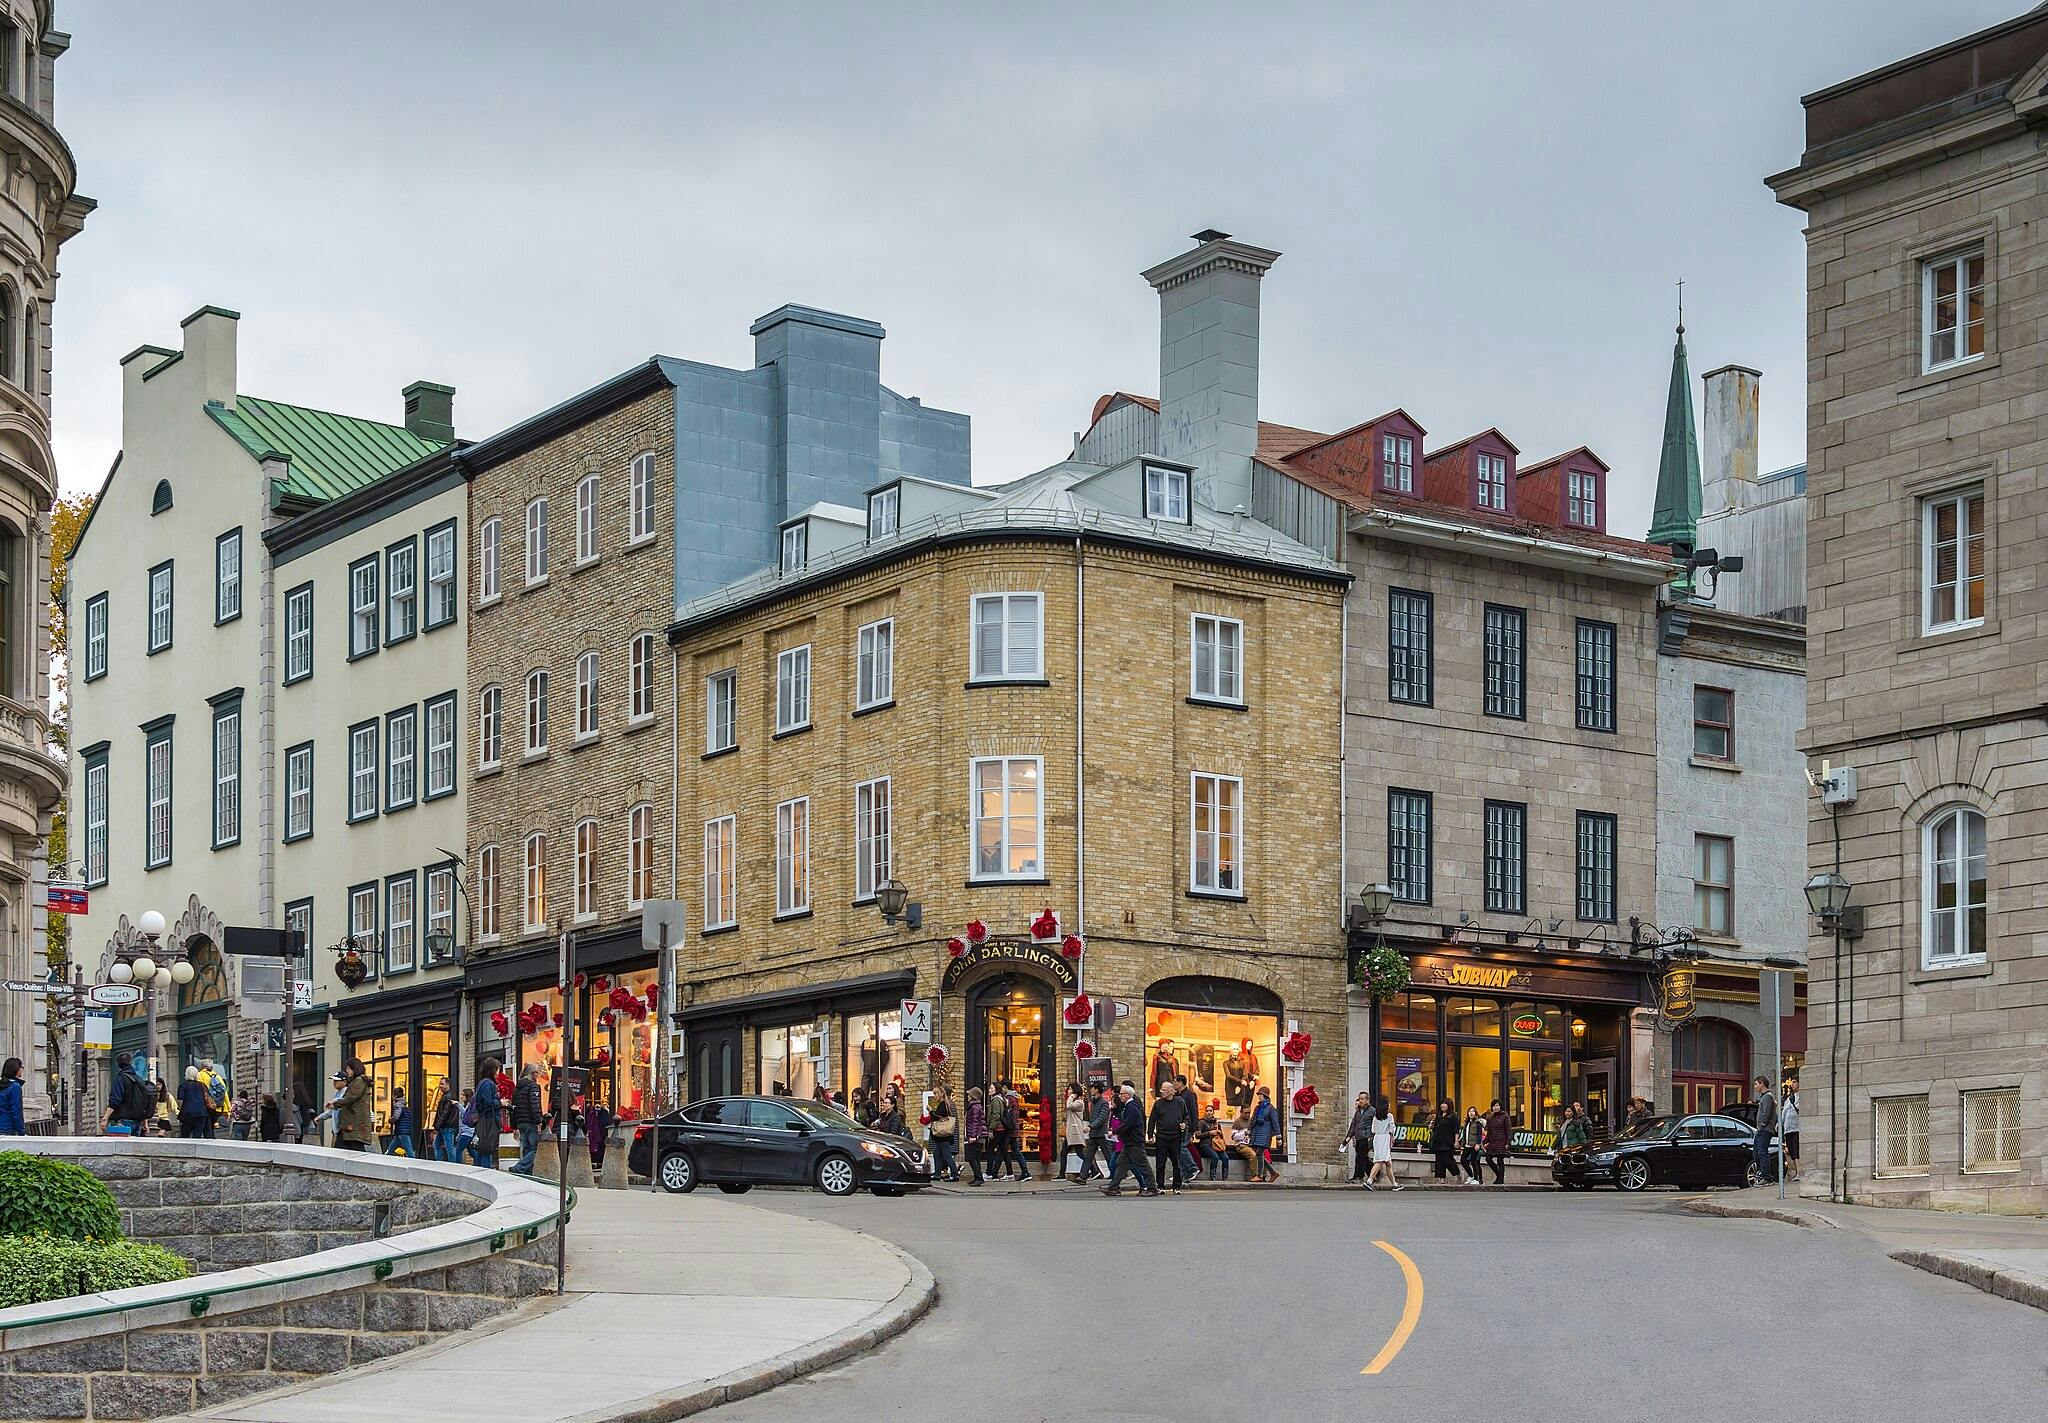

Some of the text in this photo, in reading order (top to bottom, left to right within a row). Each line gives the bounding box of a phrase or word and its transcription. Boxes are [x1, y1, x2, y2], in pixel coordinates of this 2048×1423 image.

[949, 946, 1073, 984] JOHN DARLINGTON
[1447, 963, 1518, 988] SUBWAY
[1510, 1132, 1557, 1148] SUBWAY
